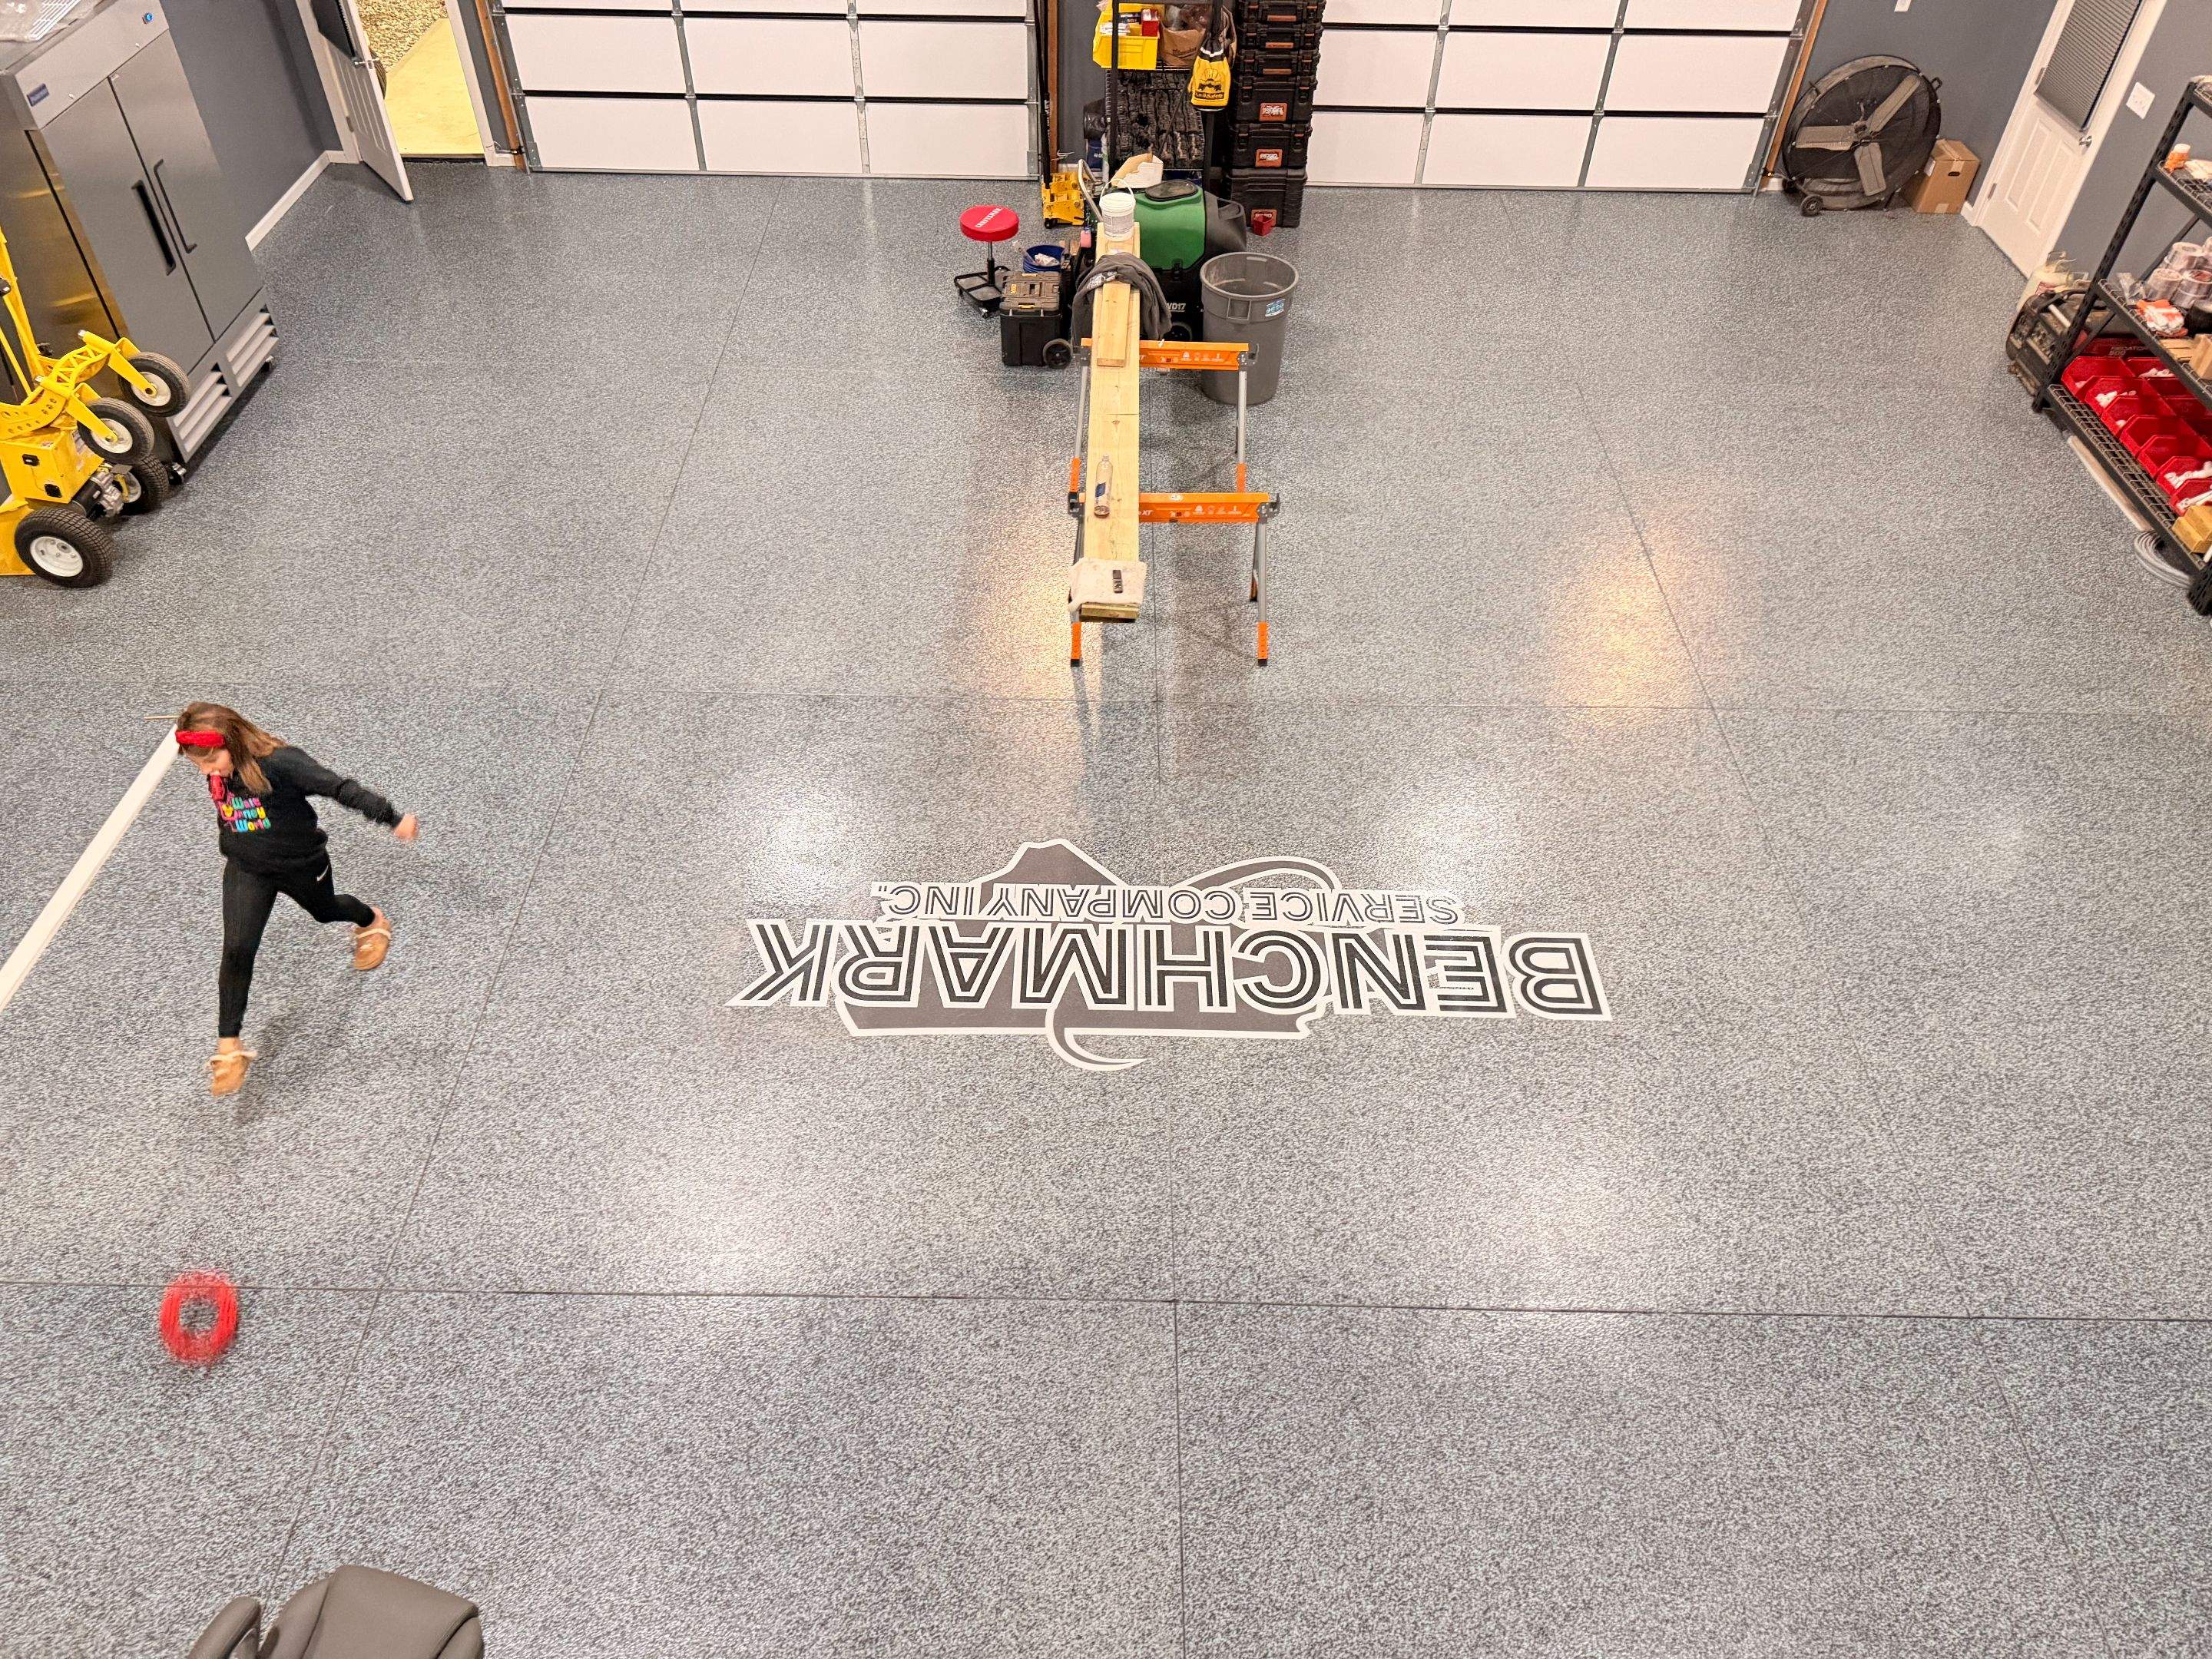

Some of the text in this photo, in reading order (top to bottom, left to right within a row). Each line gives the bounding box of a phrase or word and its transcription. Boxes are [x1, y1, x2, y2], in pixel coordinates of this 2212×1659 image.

[985, 884, 1237, 920] COMPANY
[1249, 889, 1459, 925] SERVICE
[728, 920, 1609, 1019] BENCHMARK
